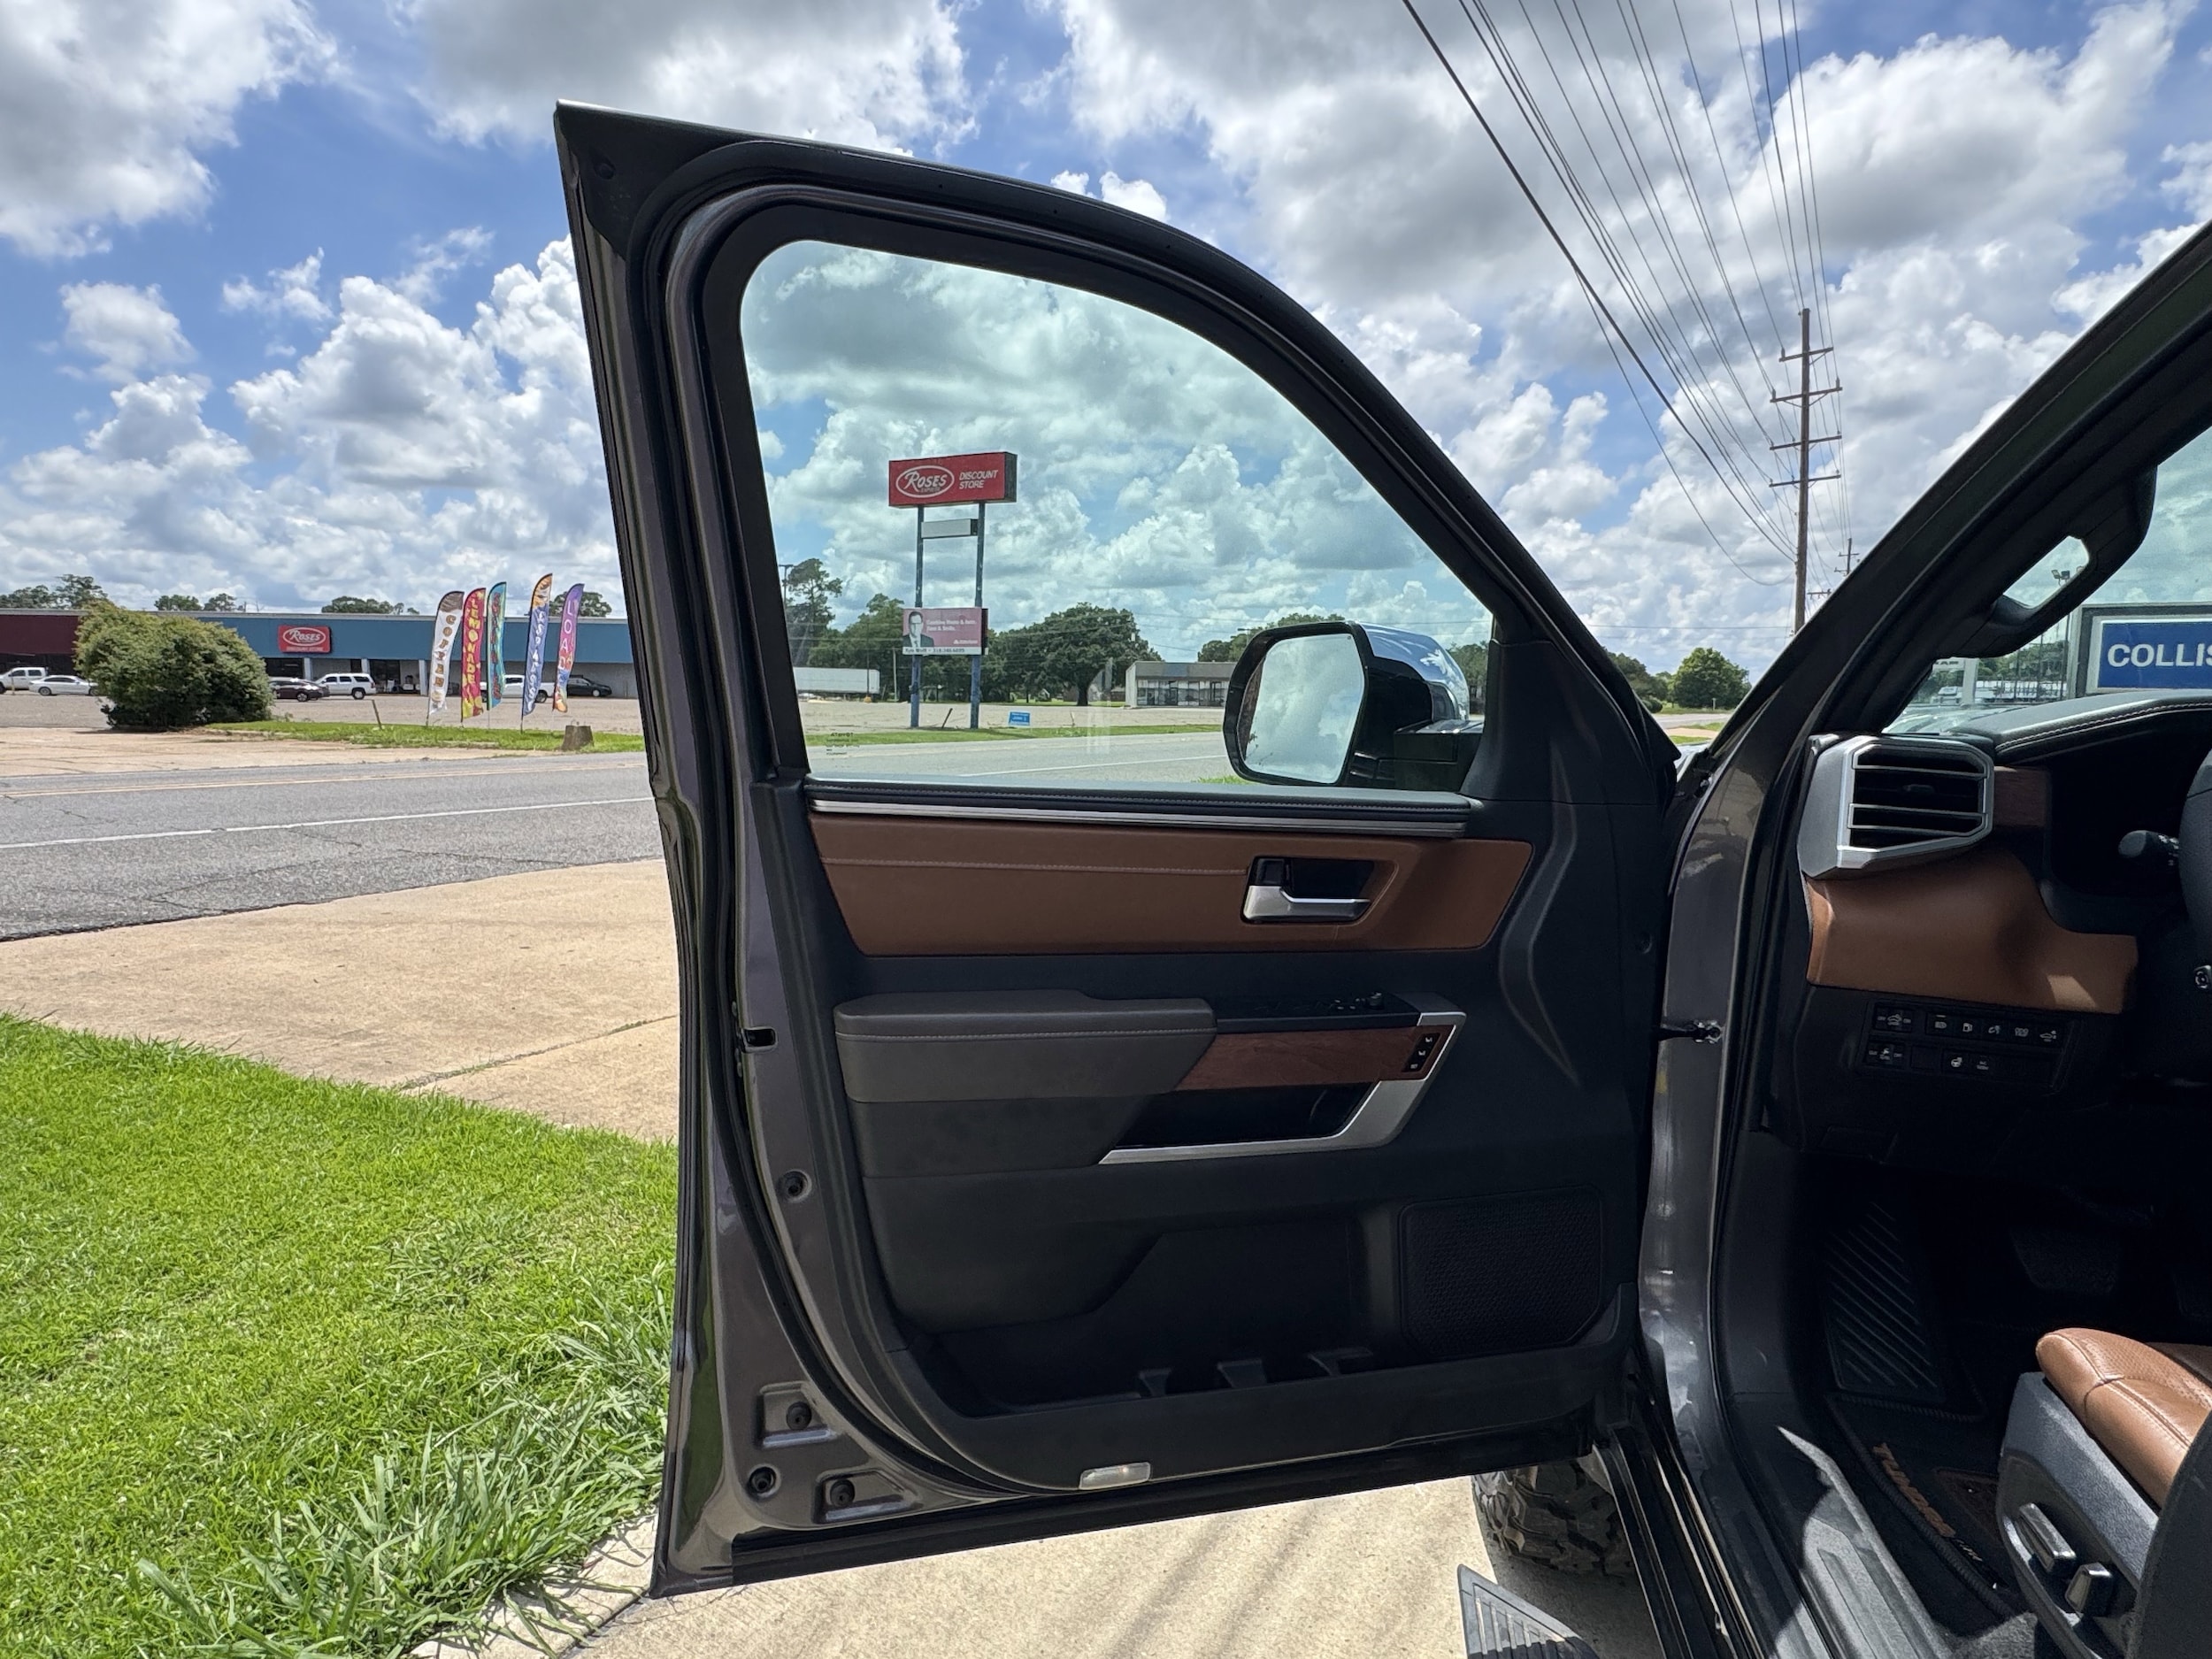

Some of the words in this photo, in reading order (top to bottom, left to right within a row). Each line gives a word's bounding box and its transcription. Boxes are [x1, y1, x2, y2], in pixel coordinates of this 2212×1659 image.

[959, 470, 998, 480] DISCOUNT
[959, 480, 985, 490] STORE
[466, 598, 481, 685] LEMONADE
